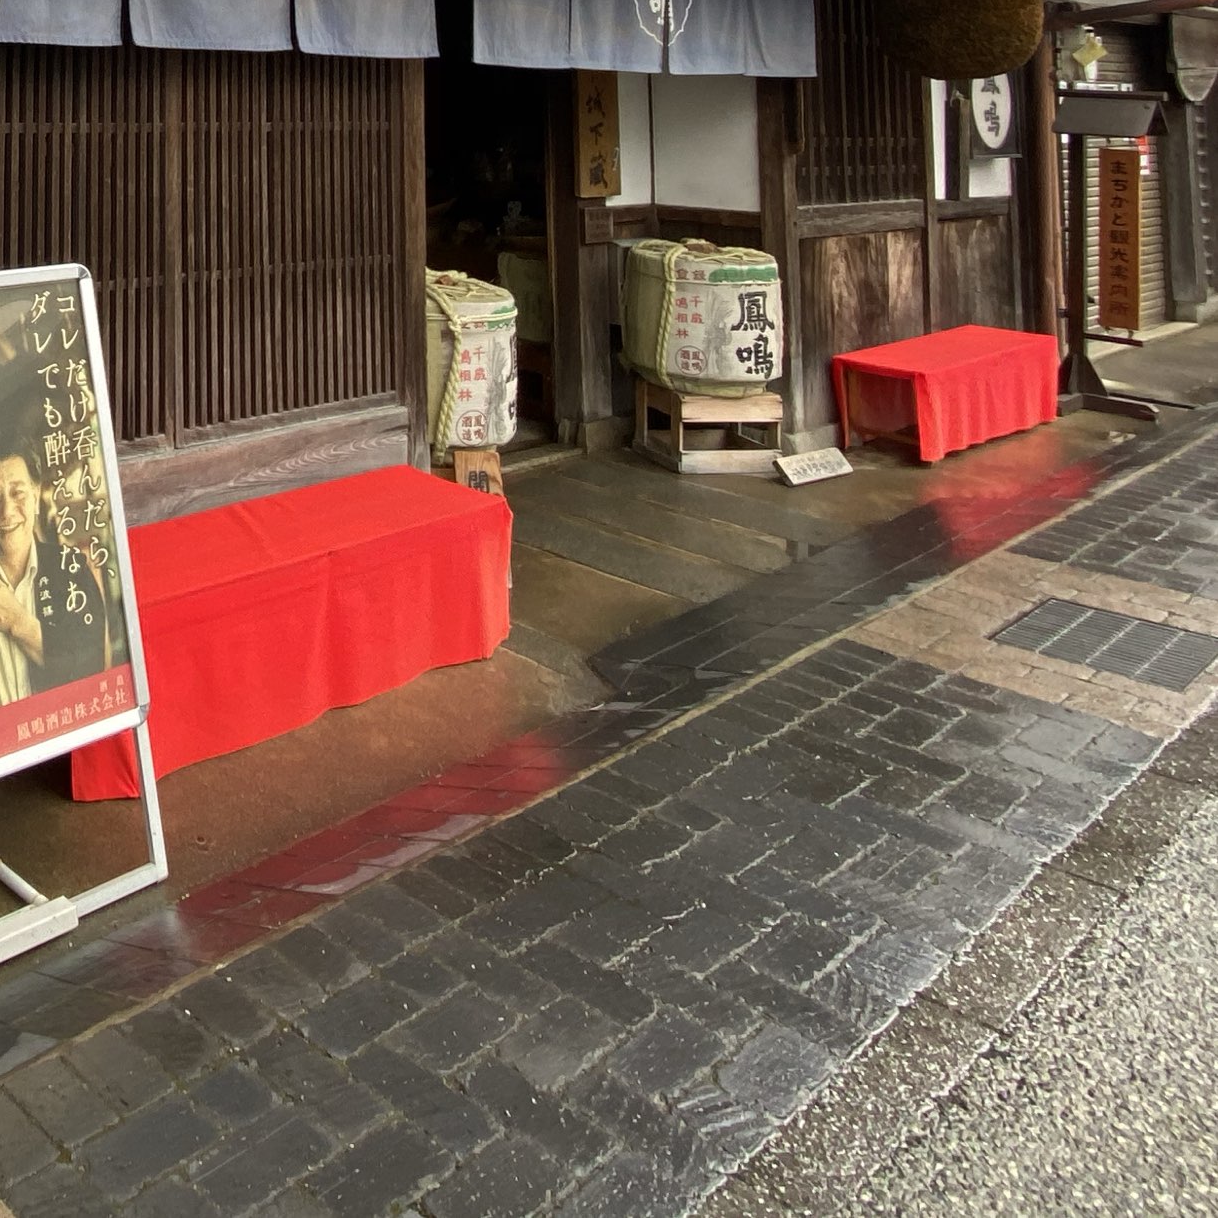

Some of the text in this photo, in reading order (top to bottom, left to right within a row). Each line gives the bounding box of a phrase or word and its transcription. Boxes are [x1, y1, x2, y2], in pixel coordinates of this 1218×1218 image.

[730, 290, 775, 380] 鳳鳴
[1108, 159, 1130, 317] まちかど観光案内所
[29, 290, 93, 625] ダレでも酔えるなあ。
[56, 294, 115, 578] コレだけ呑んだら、
